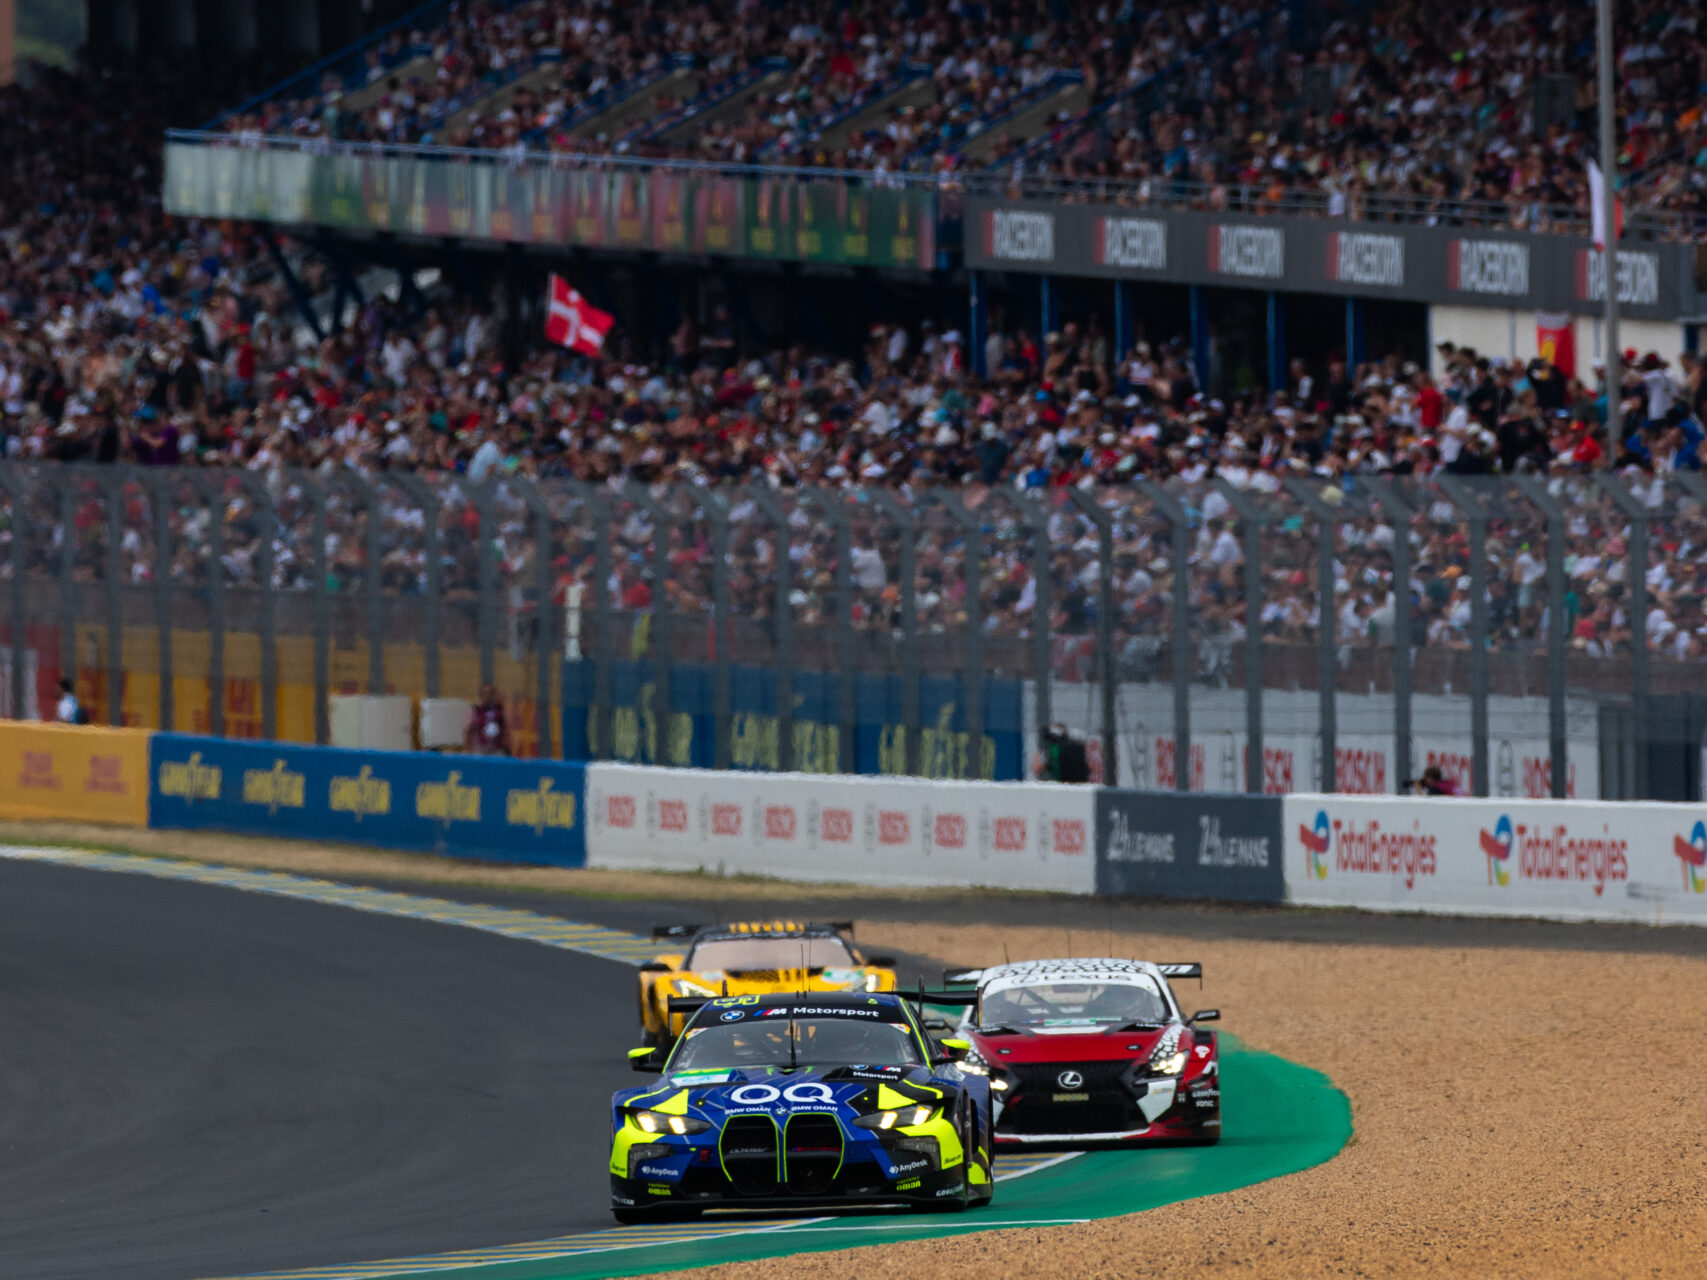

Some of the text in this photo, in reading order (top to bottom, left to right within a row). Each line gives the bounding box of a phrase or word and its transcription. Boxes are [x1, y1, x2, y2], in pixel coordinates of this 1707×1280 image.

[1333, 818, 1437, 890] TotalEnergies
[1517, 823, 1628, 896] TotalEnergies
[793, 1006, 880, 1018] Motorsport
[853, 1071, 898, 1081] Motorsport
[731, 1083, 838, 1105] OQ
[725, 1107, 744, 1115] BMW
[651, 1167, 679, 1177] AnyDesk
[899, 1159, 928, 1173] AnyDesk
